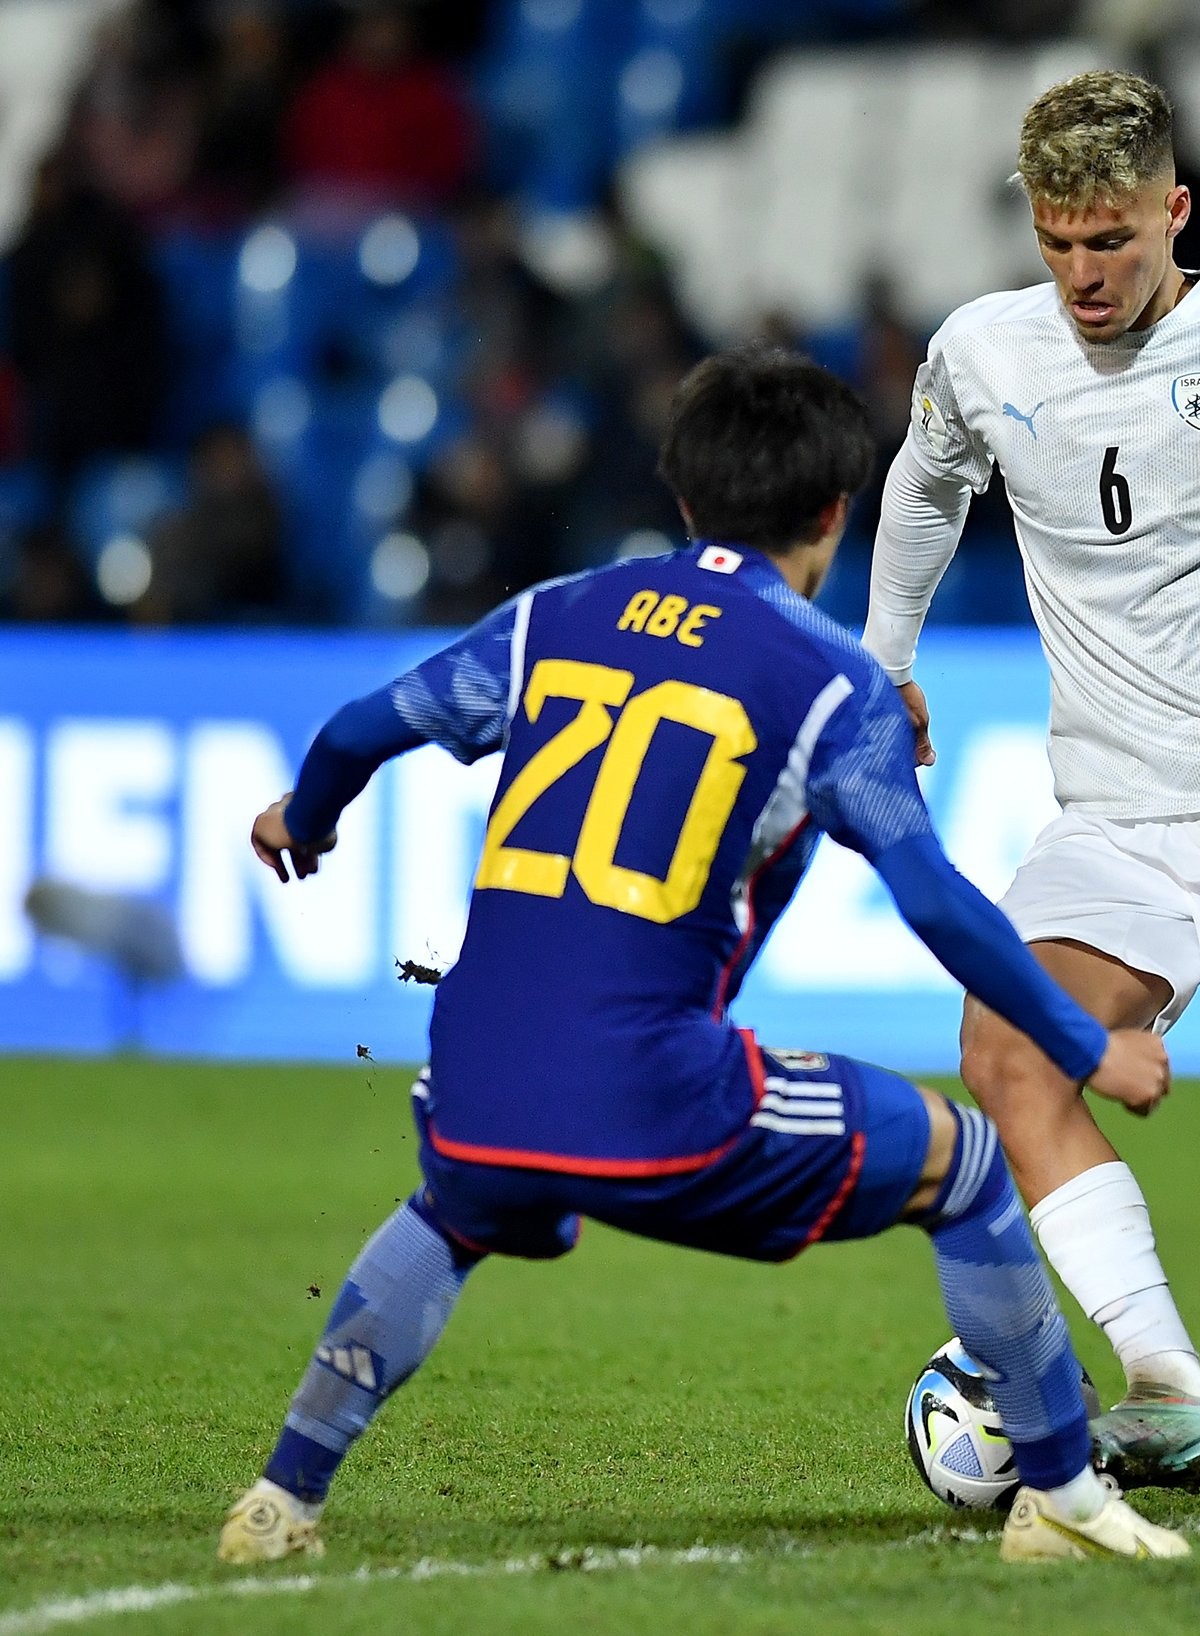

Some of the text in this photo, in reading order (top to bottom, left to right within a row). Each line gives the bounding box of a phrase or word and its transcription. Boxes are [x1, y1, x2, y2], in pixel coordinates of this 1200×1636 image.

[1099, 446, 1133, 536] 6
[616, 589, 723, 648] ABE
[475, 658, 757, 924] 20
